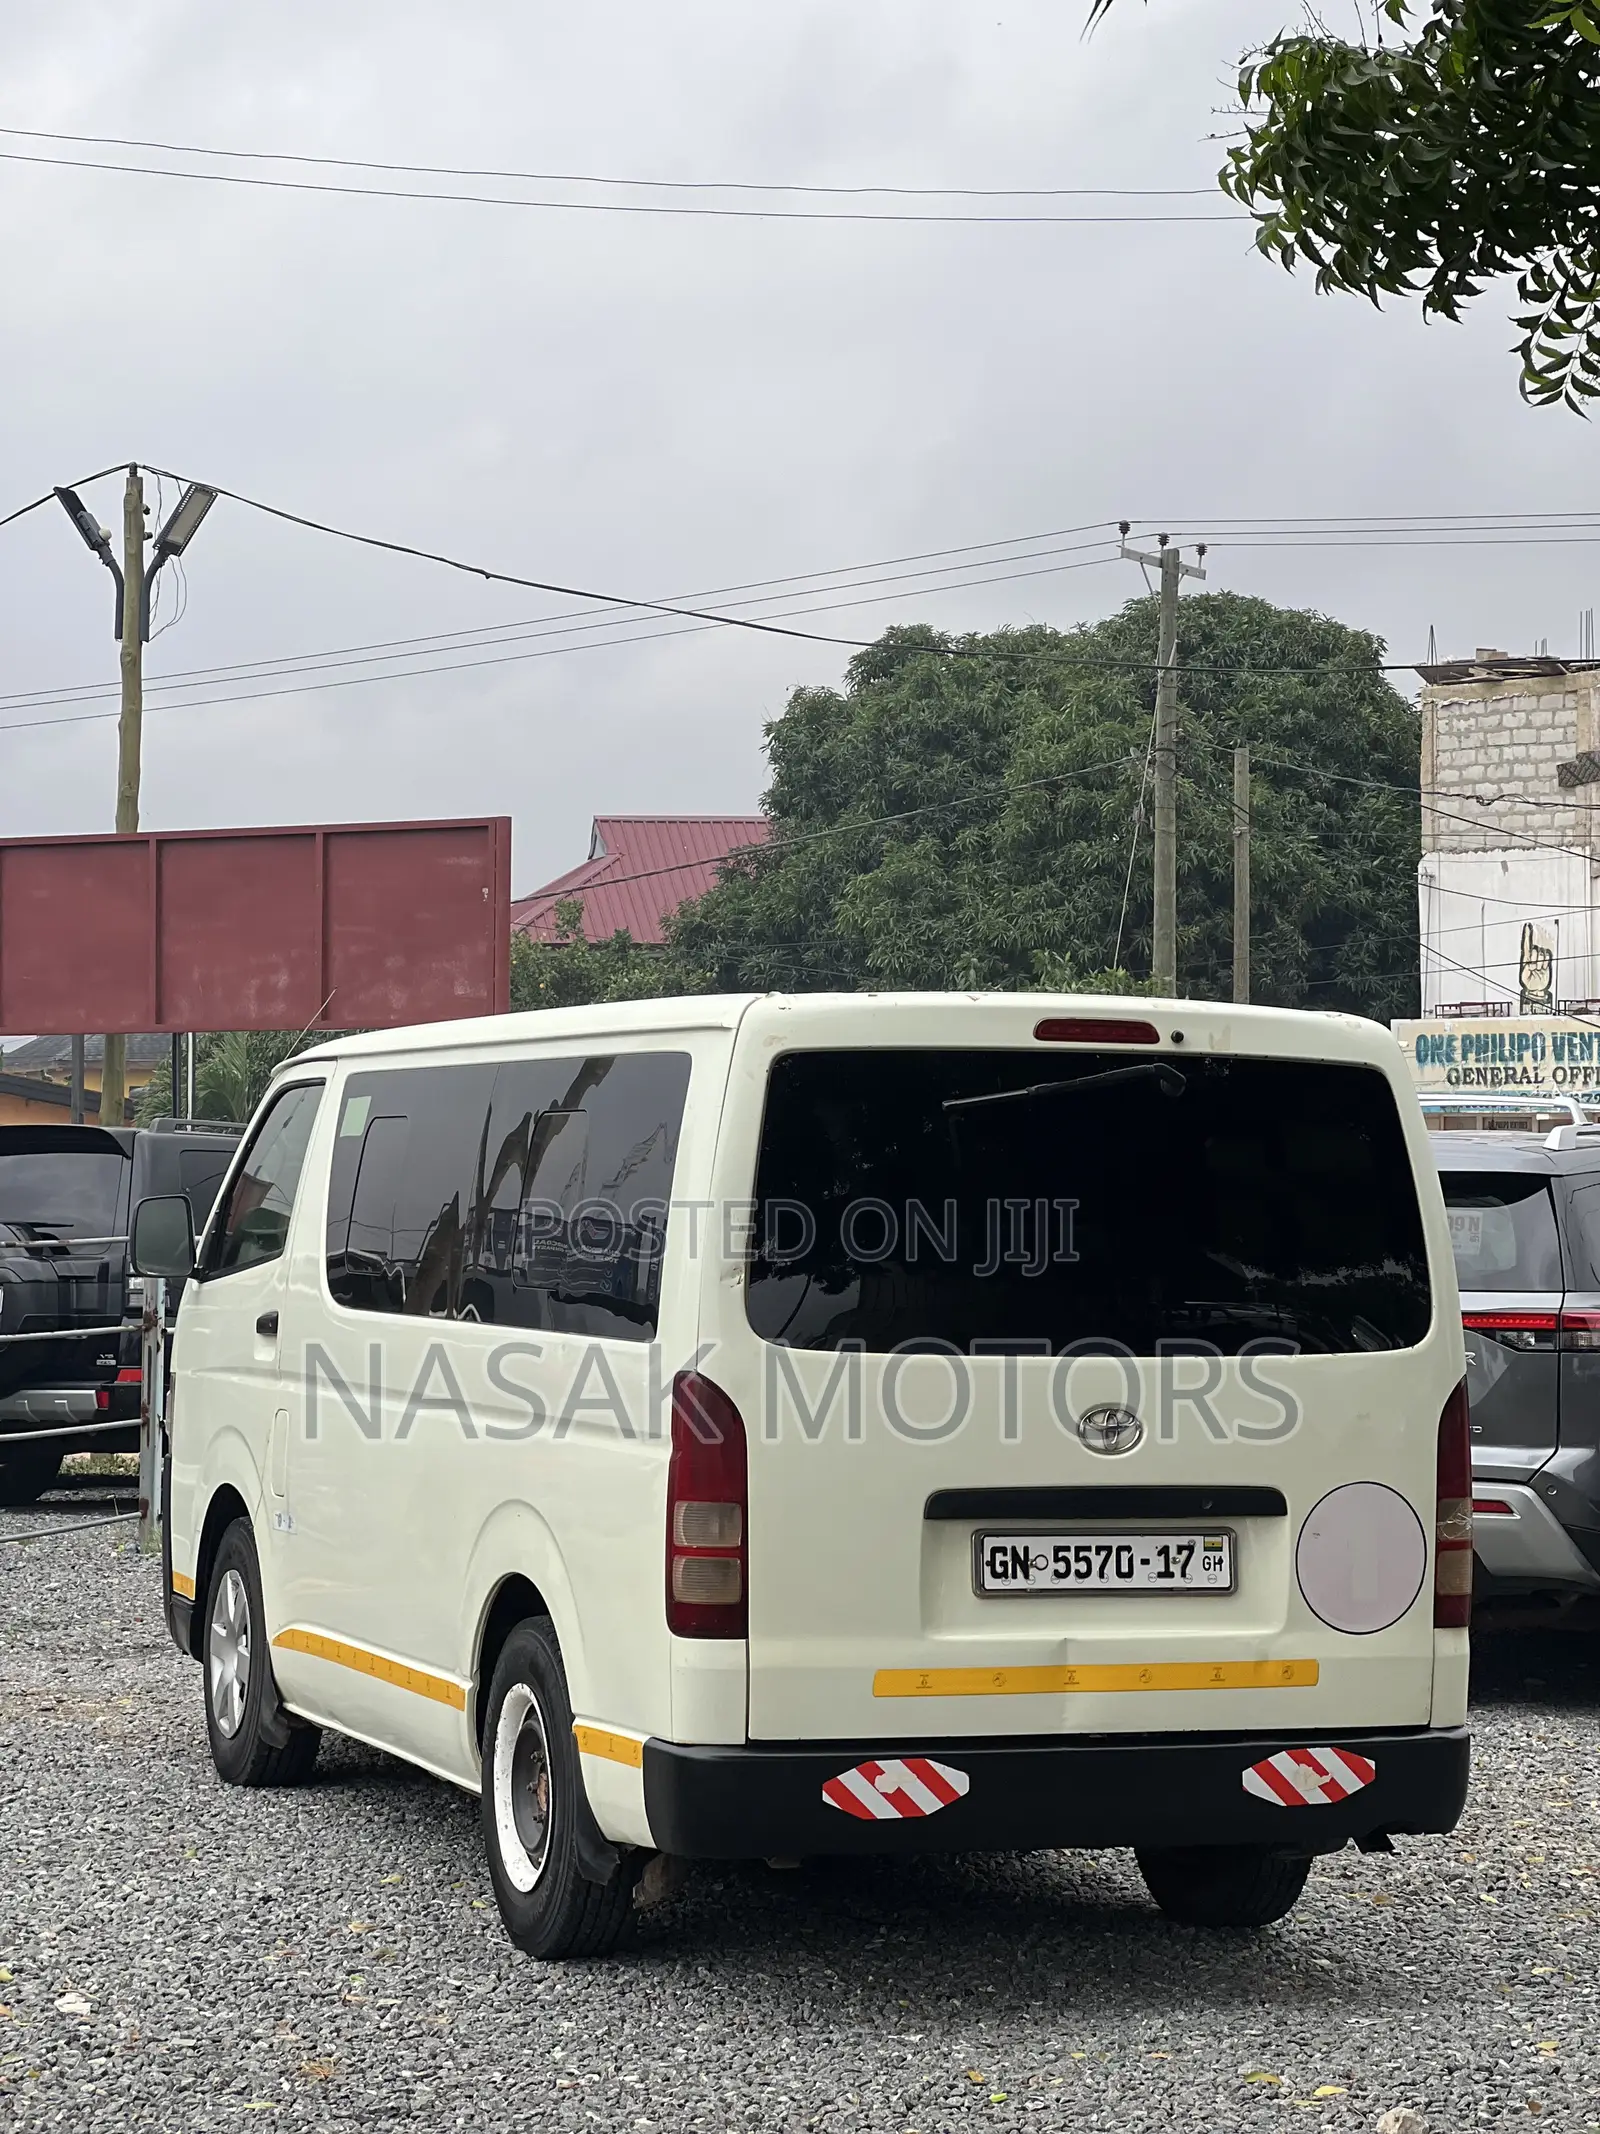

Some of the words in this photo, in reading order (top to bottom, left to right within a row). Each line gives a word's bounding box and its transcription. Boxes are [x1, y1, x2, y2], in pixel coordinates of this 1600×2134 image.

[1415, 1033, 1459, 1064] ONE
[1461, 1032, 1547, 1062] PHILIPO
[1446, 1066, 1545, 1086] GENERAL
[989, 1545, 1030, 1579] GN
[1202, 1555, 1224, 1572] GH
